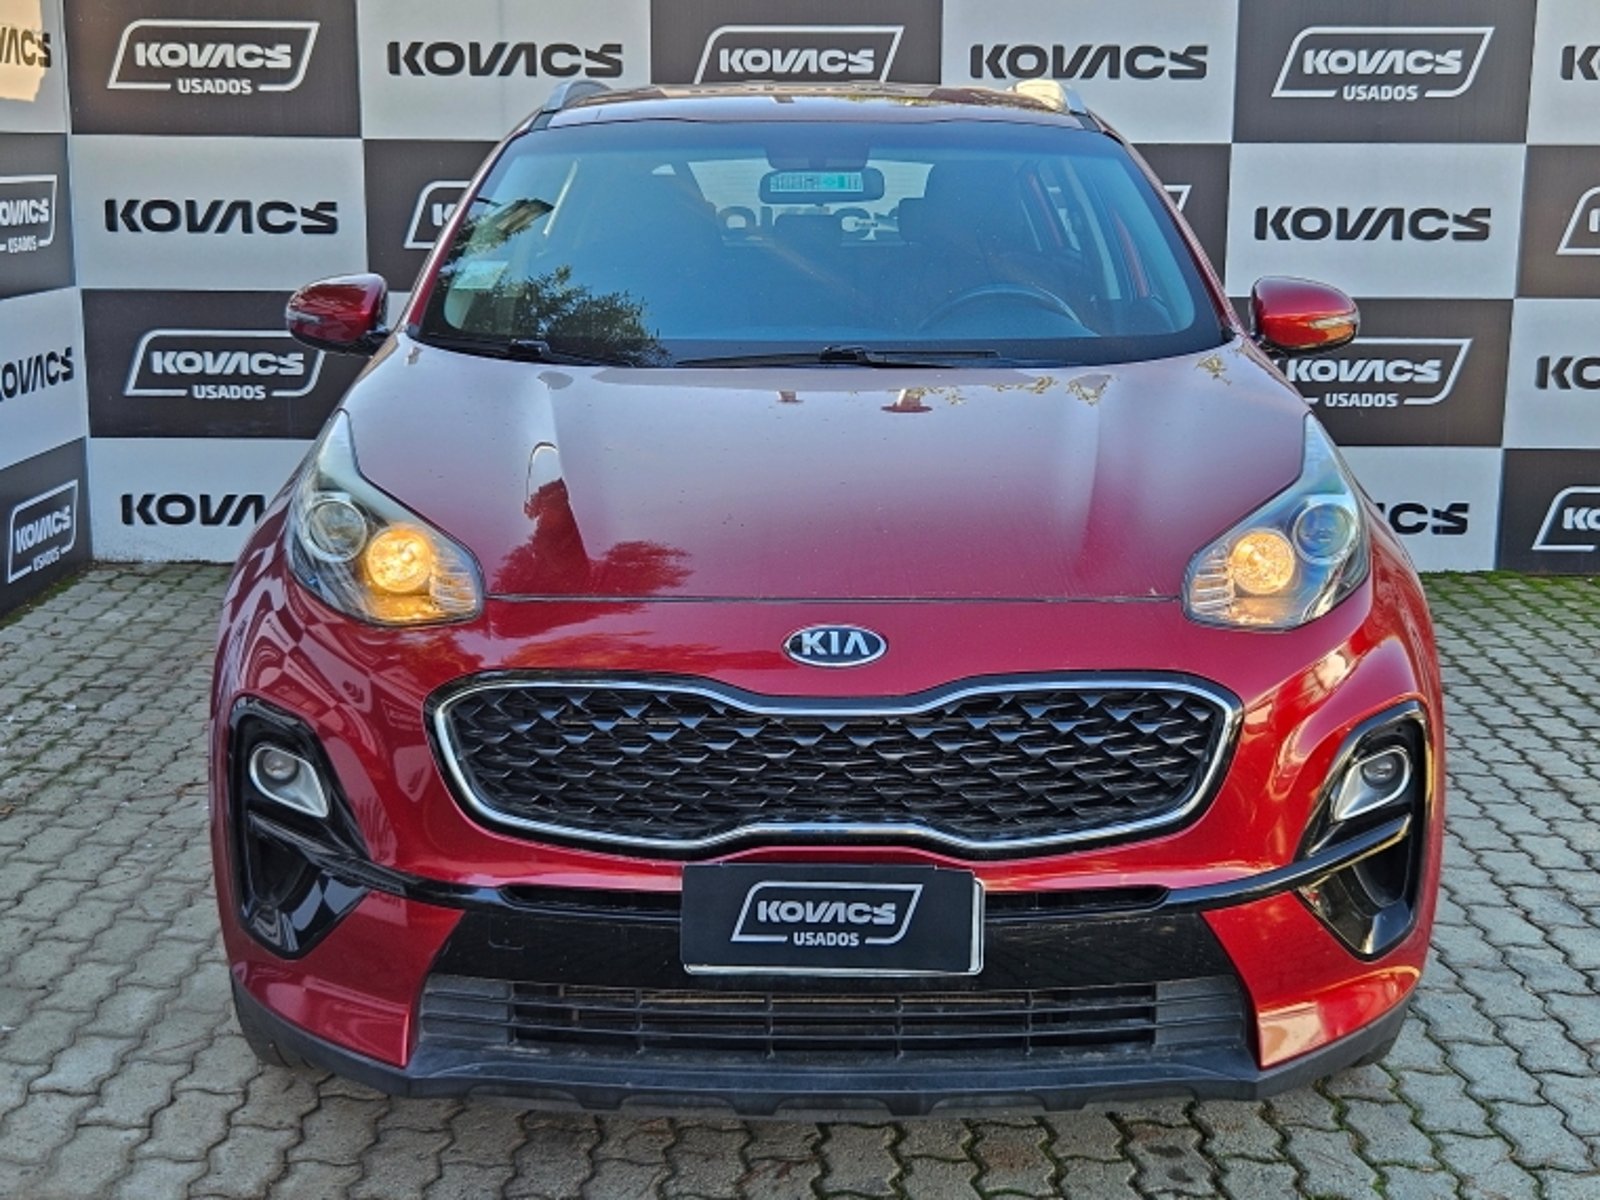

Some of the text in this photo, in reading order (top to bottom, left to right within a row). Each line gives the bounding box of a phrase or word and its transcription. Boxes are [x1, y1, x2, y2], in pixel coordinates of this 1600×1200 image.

[135, 43, 291, 68] KOVACS
[387, 41, 623, 77] KOVACS
[719, 49, 875, 73] KOVACS
[970, 45, 1208, 79] KOVACS
[1303, 50, 1462, 75] KOVACS
[177, 79, 252, 95] USADOS
[1342, 85, 1418, 101] USADOS
[105, 199, 338, 234] KOVACS
[1254, 207, 1491, 241] KOVACS
[0, 347, 74, 402] OVACS
[151, 351, 304, 375] KOVACS
[1286, 359, 1442, 382] KOVACS
[192, 385, 266, 400] USADOS
[1325, 393, 1399, 407] USADOS
[15, 505, 71, 554] KOVACS
[801, 631, 871, 656] KIA
[757, 901, 895, 925] KOVACS
[793, 932, 858, 946] USADOS
